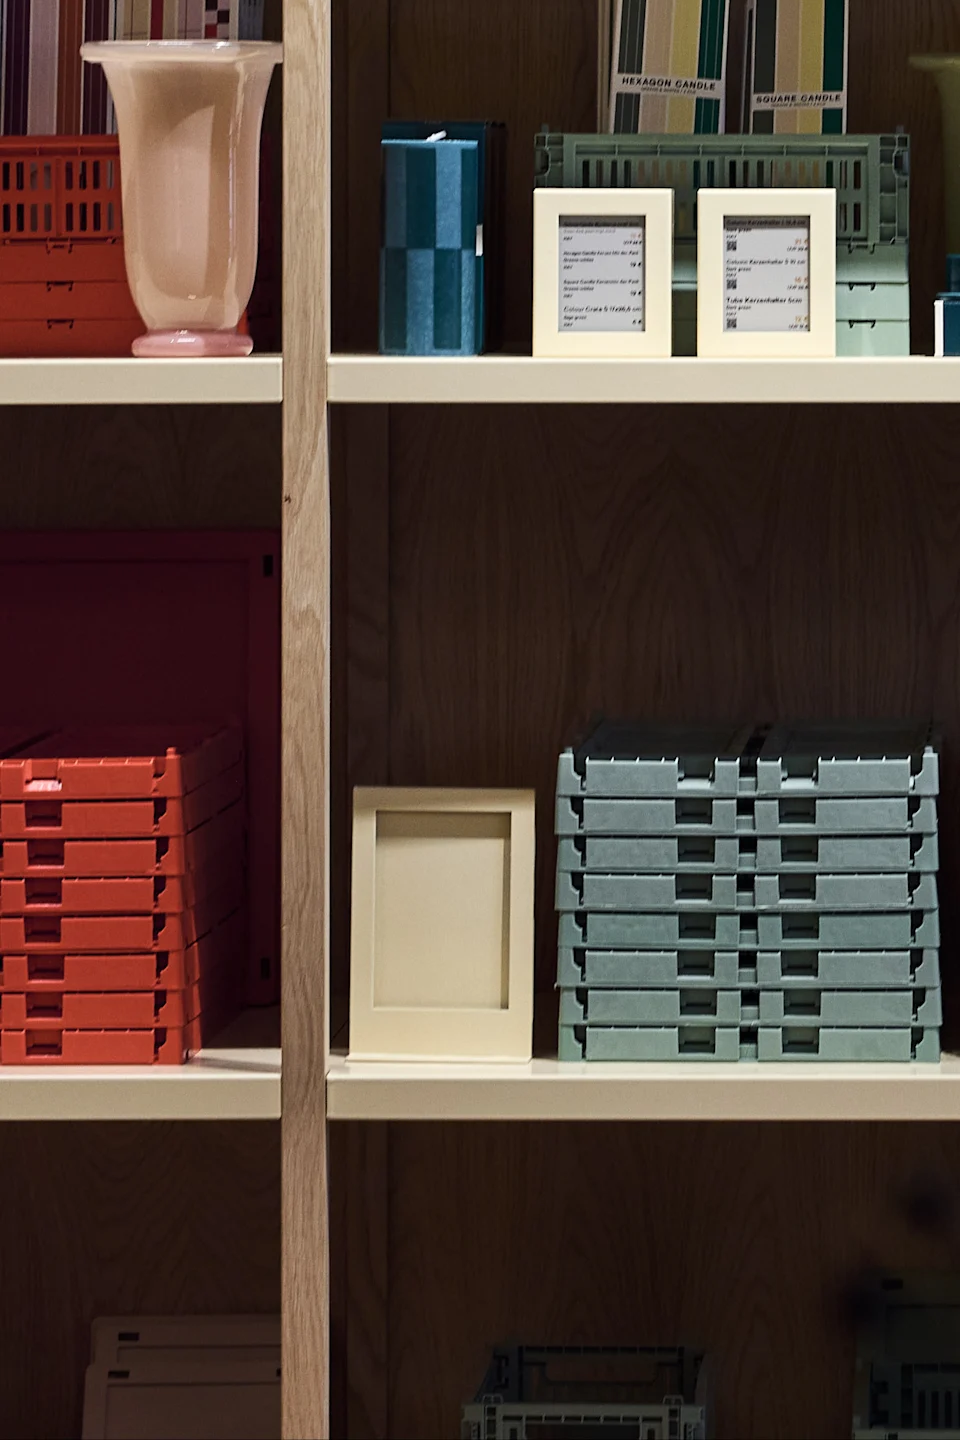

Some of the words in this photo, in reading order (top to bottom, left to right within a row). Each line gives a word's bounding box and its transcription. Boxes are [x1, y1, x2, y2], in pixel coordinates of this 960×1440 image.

[622, 76, 671, 87] HEXAGON
[676, 80, 716, 91] CANDLE
[756, 95, 797, 104] SQUARE
[800, 94, 841, 102] CANDLE
